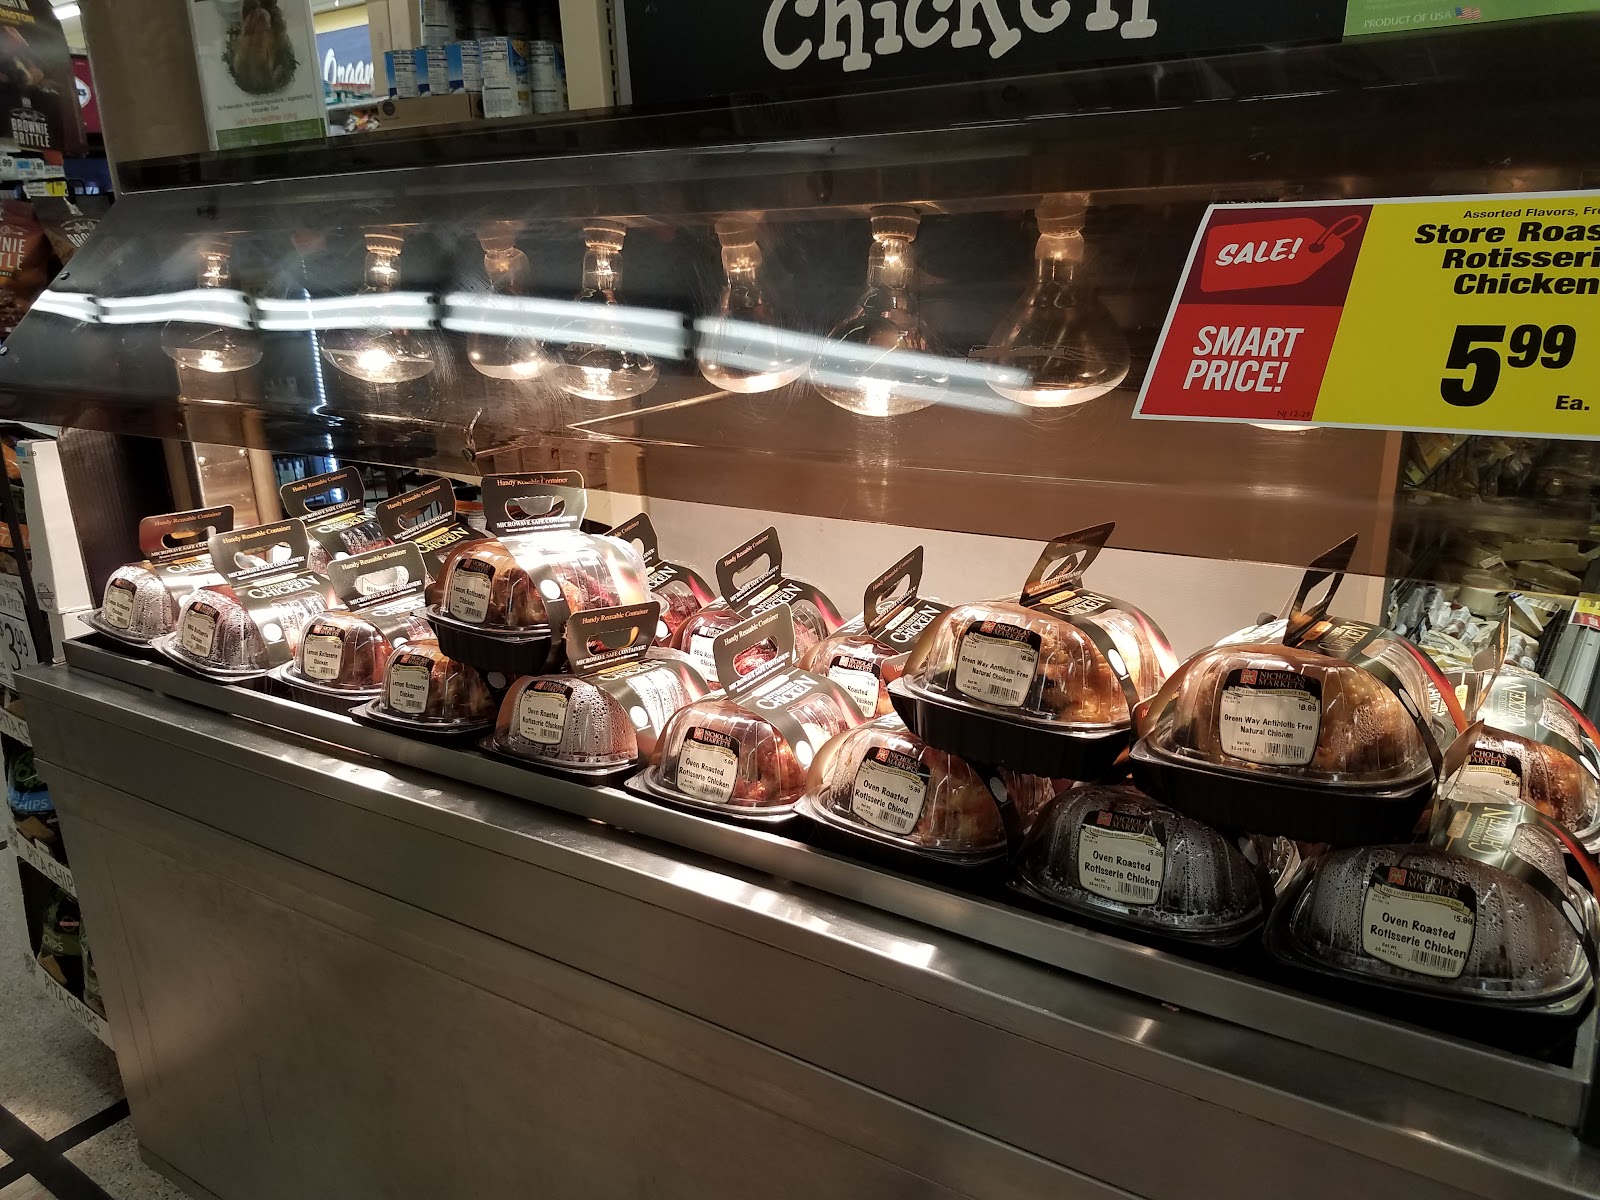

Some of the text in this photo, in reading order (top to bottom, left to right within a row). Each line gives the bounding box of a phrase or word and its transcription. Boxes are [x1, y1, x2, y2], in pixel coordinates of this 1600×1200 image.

[1364, 12, 1451, 28] PRODUCT OF USA
[11, 117, 49, 135] BROWNIE
[13, 130, 51, 148] BRITTLE
[1463, 209, 1522, 219] Assorted
[1525, 208, 1579, 218] Flavors,
[1414, 223, 1506, 244] Store
[1214, 237, 1304, 267] SALE!
[1453, 273, 1600, 295] Chicken
[1192, 325, 1304, 358] SMART
[1182, 360, 1289, 393] PRICE!
[1555, 395, 1591, 411] Ea.
[223, 535, 241, 544] Handy
[265, 525, 291, 535] Container
[341, 560, 360, 571] Handy
[383, 549, 407, 560] Container
[247, 575, 320, 598] CHICKEN
[582, 609, 649, 624] Handy Reusable Container
[890, 604, 941, 643] CHICKEN
[723, 634, 738, 646] Handy
[758, 613, 779, 628] Container
[993, 629, 1028, 643] MARKETS
[995, 623, 1031, 637] NICHOLAS
[961, 655, 1029, 679] Green Way Antibiotic Free
[972, 666, 1013, 684] Natural Chicken
[1260, 671, 1306, 682] NICHOLAS
[1258, 678, 1305, 690] MARKETS
[1224, 713, 1313, 731] Green Way Antibiotic Free
[1240, 725, 1294, 739] Natural Chicken
[679, 766, 730, 789] Rotisserie Chicken
[685, 757, 725, 777] Oven Roasted
[863, 779, 909, 805] Oven Roasted
[854, 788, 914, 819] Rotisserie Chicken
[1468, 806, 1514, 854] CHICKEN
[1092, 850, 1151, 872] Oven Roasted
[1084, 861, 1161, 888] Rotisserie Chicken
[1409, 871, 1460, 890] NICHOLAS
[1407, 880, 1459, 898] MARKETS
[1382, 912, 1456, 941] Oven Roasted
[1370, 924, 1421, 947] Rotisserie
[1424, 939, 1467, 960] Chicken
[66, 998, 101, 1033] CHIPS
